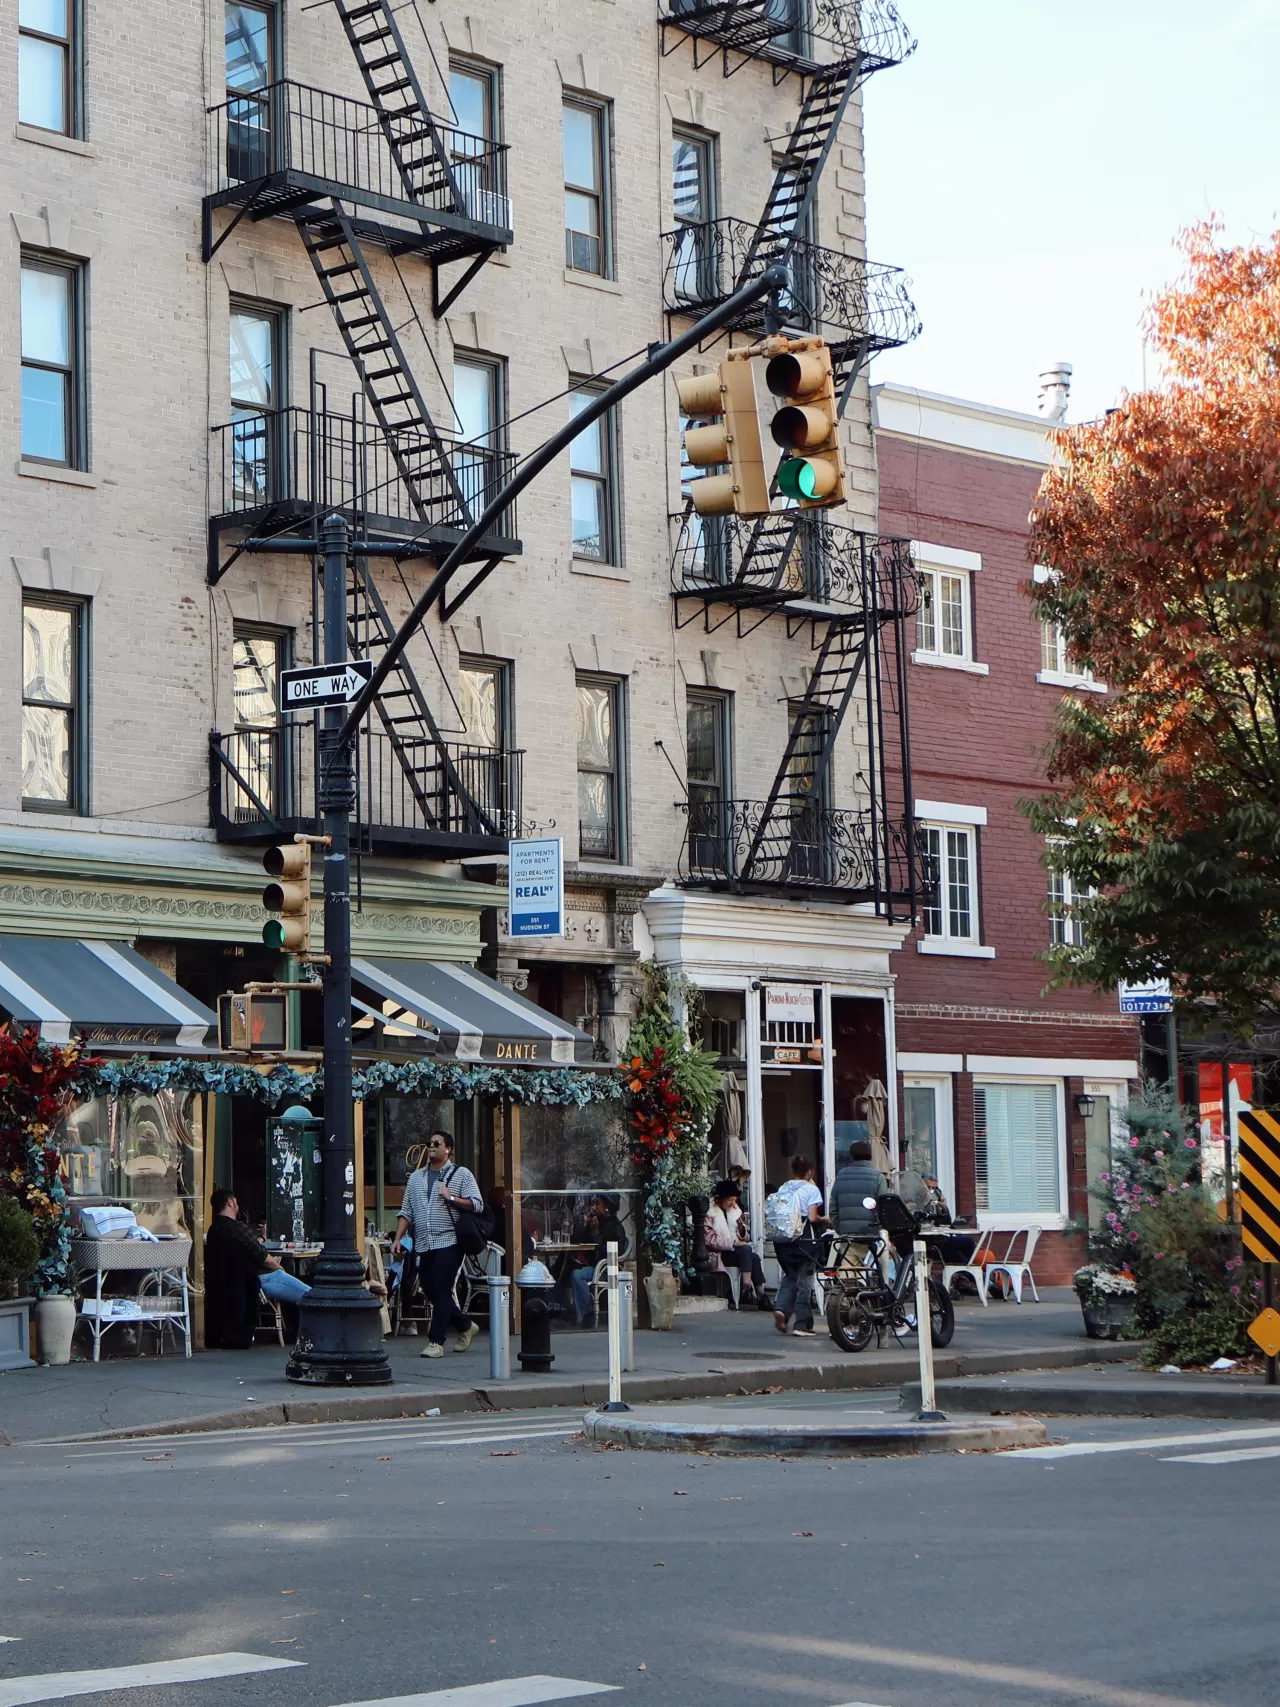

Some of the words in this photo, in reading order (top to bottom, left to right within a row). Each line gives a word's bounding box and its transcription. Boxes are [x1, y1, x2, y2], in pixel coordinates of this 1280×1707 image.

[294, 680, 319, 697] ONE
[331, 675, 358, 693] WAY
[516, 849, 555, 858] APARTMENTS
[89, 1027, 114, 1042] New
[115, 1027, 143, 1044] York
[143, 1028, 161, 1045] City
[496, 1042, 538, 1060] DANTE
[58, 1152, 97, 1178] NTE
